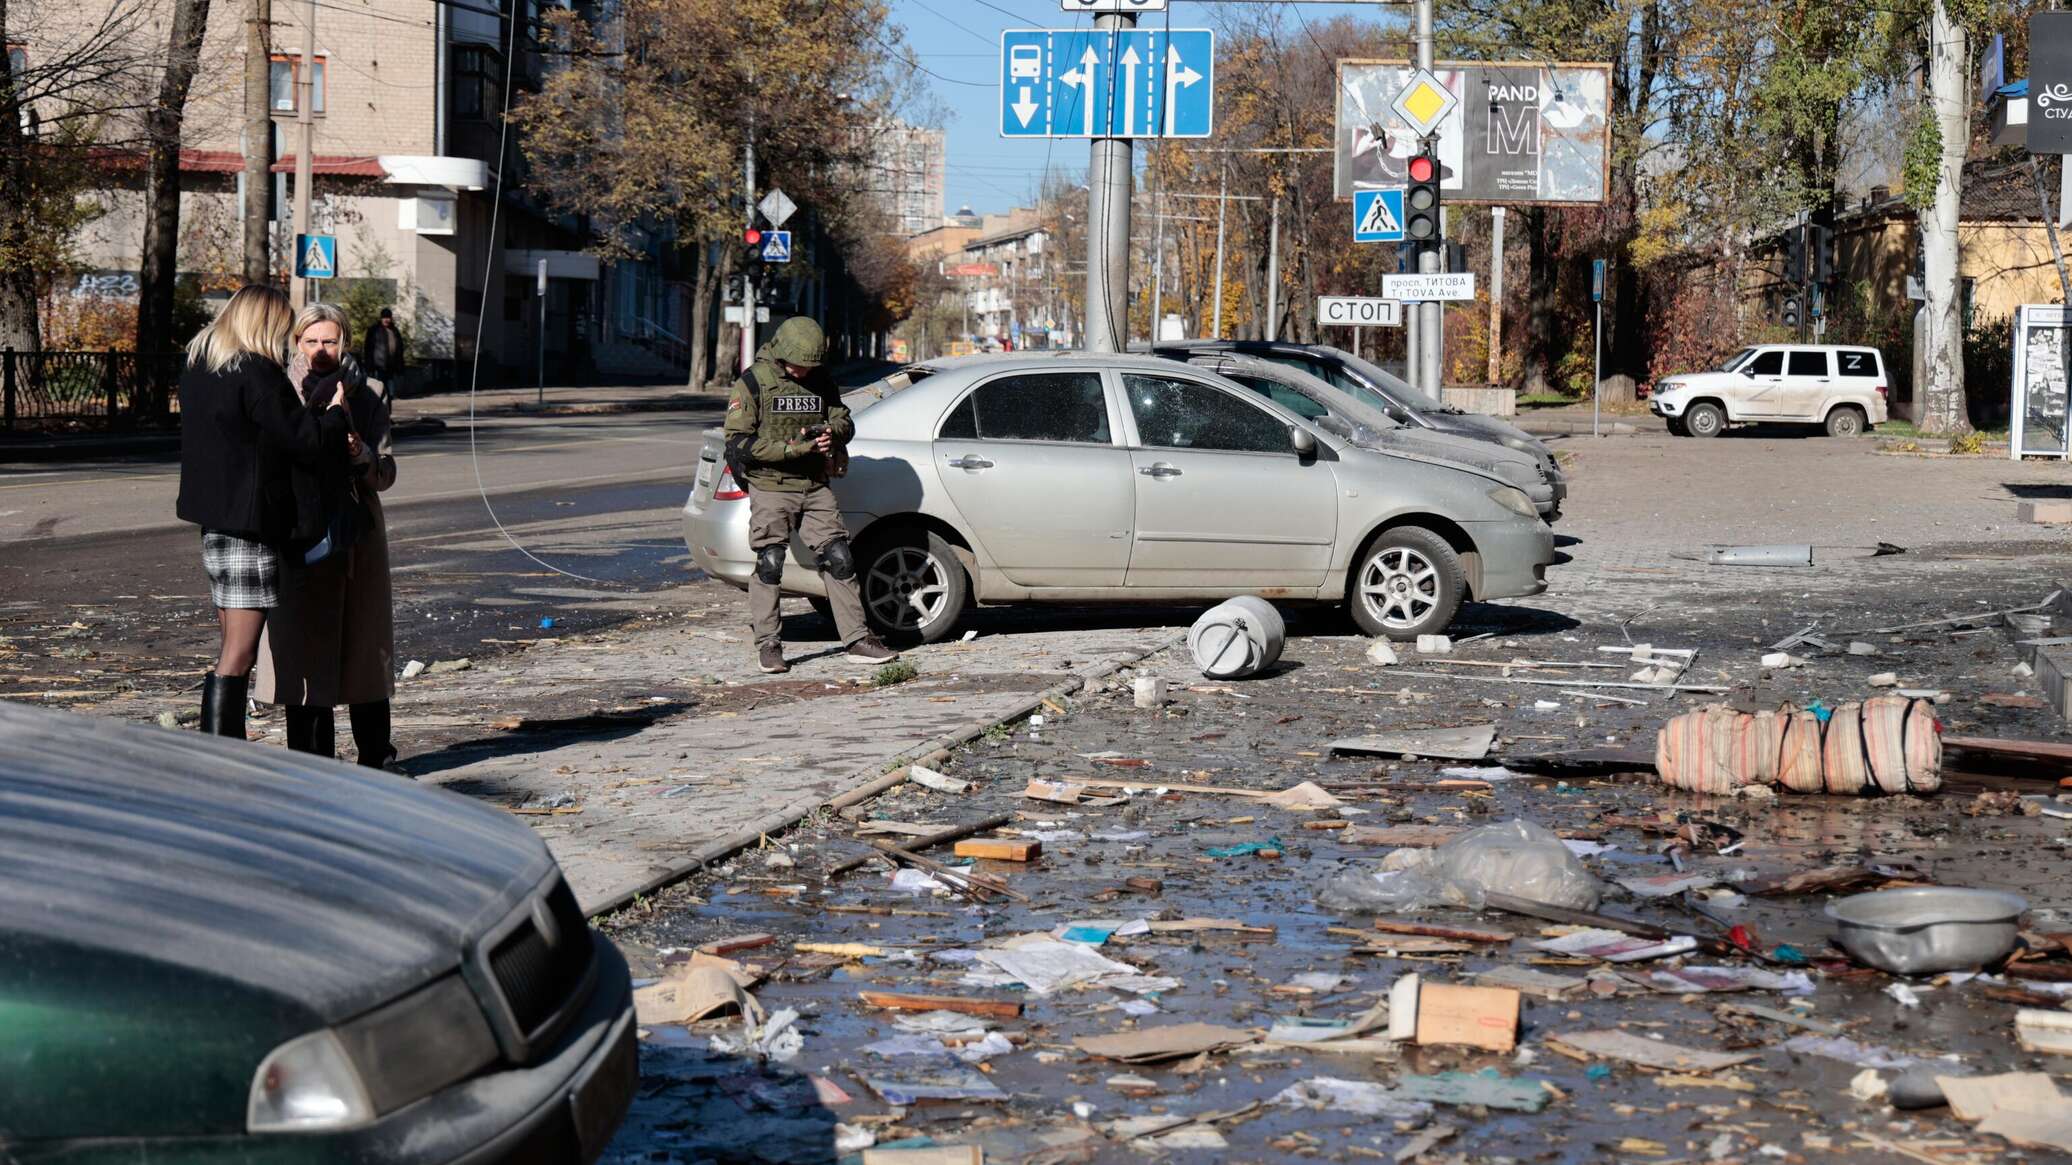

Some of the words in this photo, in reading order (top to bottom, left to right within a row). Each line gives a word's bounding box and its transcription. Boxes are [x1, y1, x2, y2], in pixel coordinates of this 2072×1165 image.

[1488, 85, 1541, 101] PAND
[1426, 278, 1466, 287] ТИТОВА
[1328, 302, 1391, 321] СТОП
[1846, 355, 1862, 369] Z
[777, 398, 817, 411] PRESS
